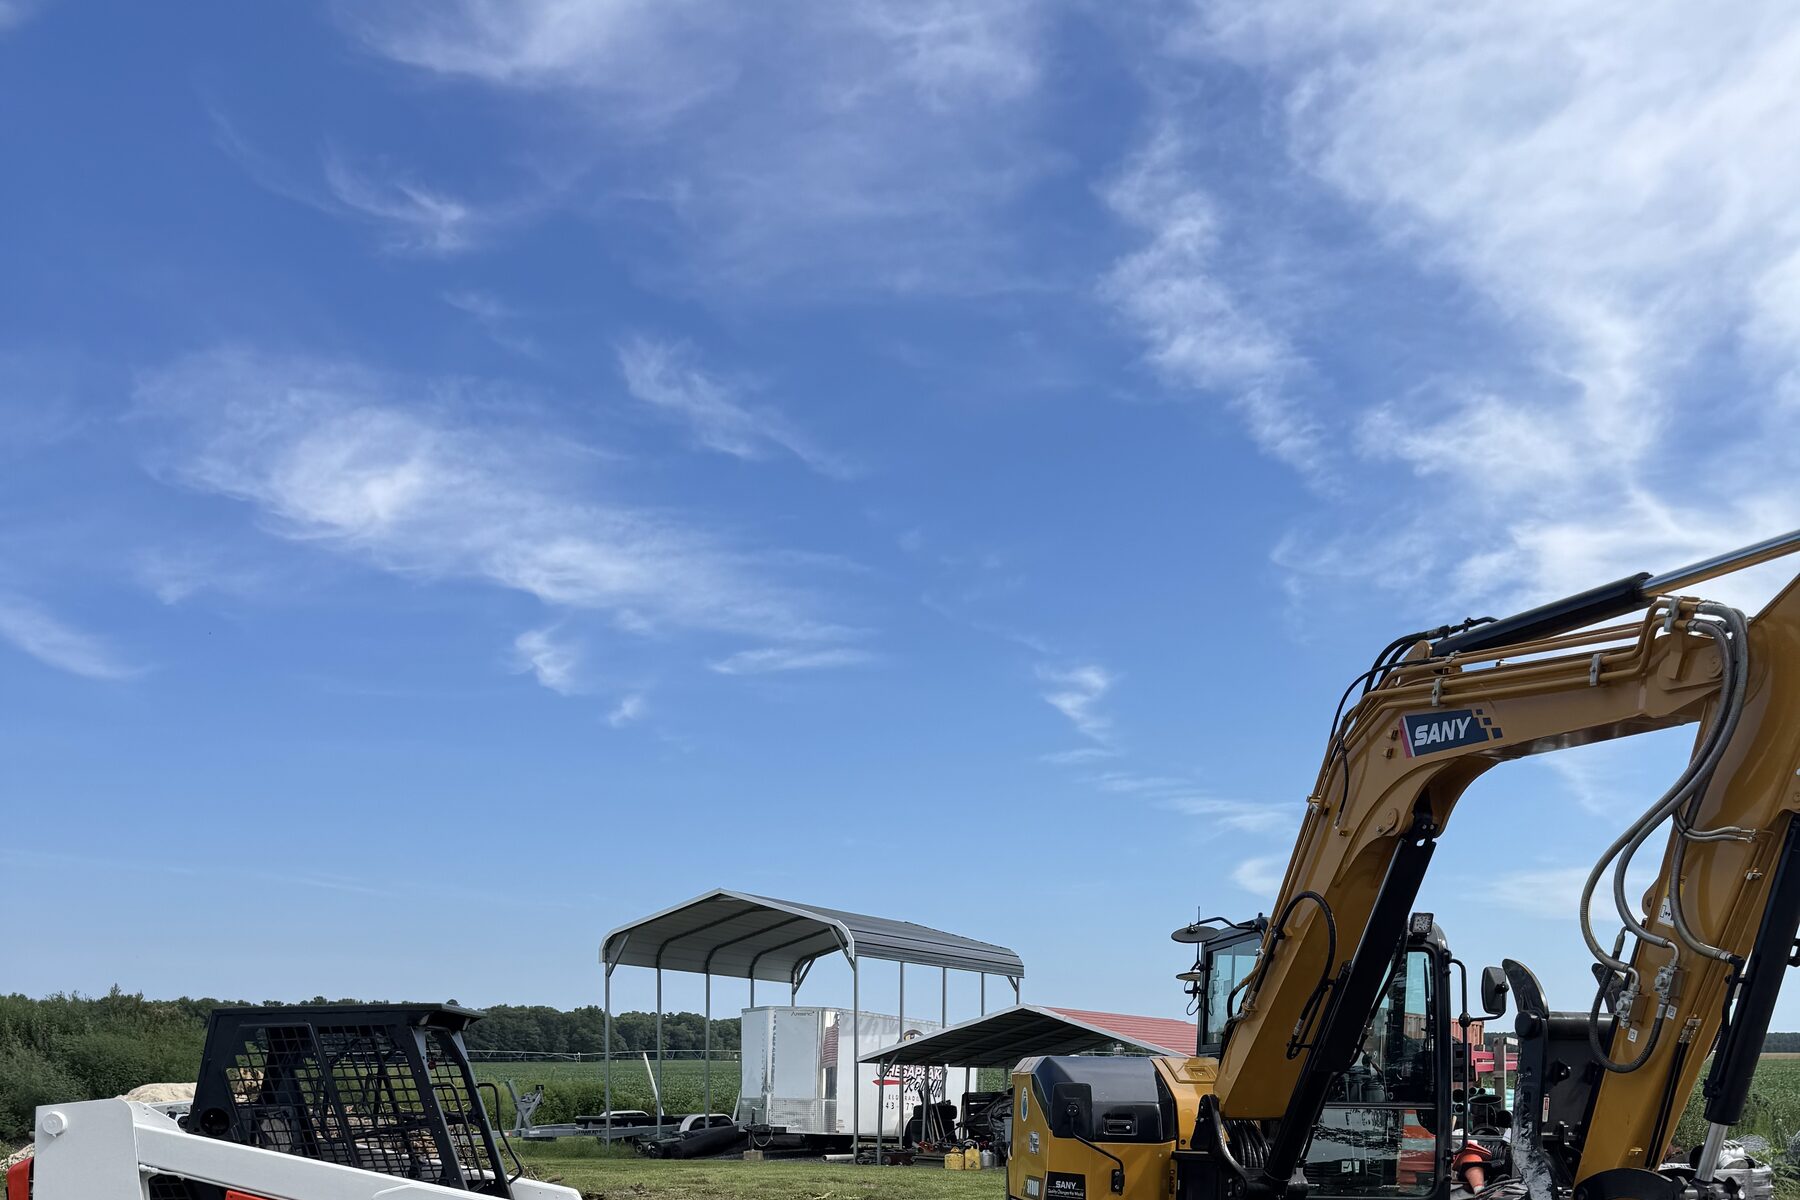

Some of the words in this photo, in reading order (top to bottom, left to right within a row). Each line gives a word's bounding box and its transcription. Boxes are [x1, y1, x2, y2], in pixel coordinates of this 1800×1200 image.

[1414, 716, 1472, 747] SANY
[876, 1063, 943, 1080] HESAPEAK
[1055, 1180, 1076, 1189] SANY
